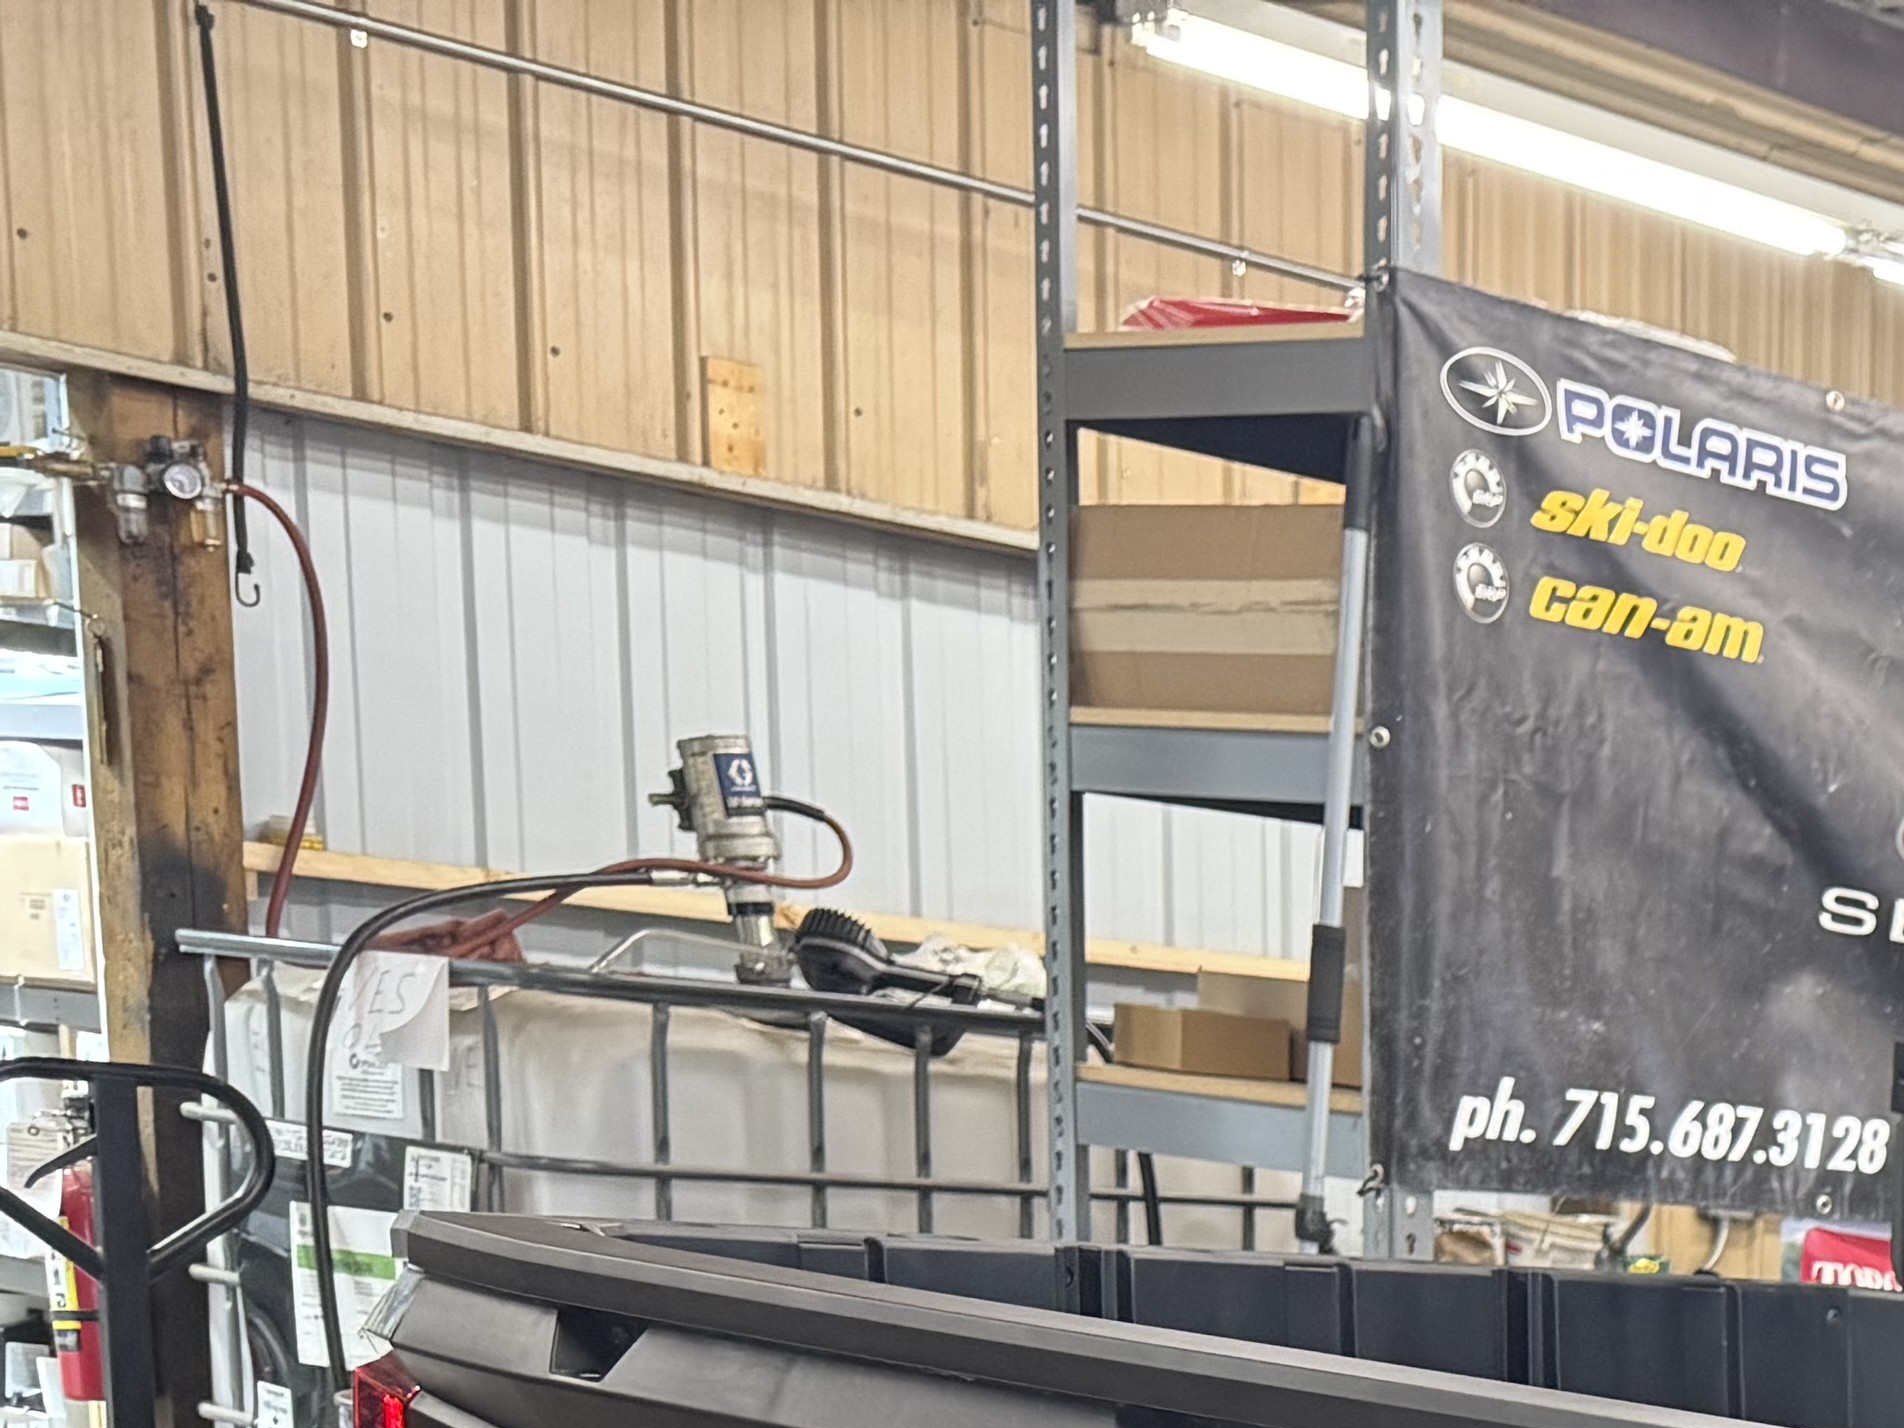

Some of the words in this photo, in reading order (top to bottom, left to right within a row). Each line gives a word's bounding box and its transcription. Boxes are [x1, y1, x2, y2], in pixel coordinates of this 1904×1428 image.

[1556, 378, 1848, 511] POLARIS
[1530, 488, 1746, 573] ski-doo
[1529, 575, 1765, 664] can-am
[1448, 1076, 1537, 1152] ph.
[1553, 1088, 1891, 1175] 715.687.3128
